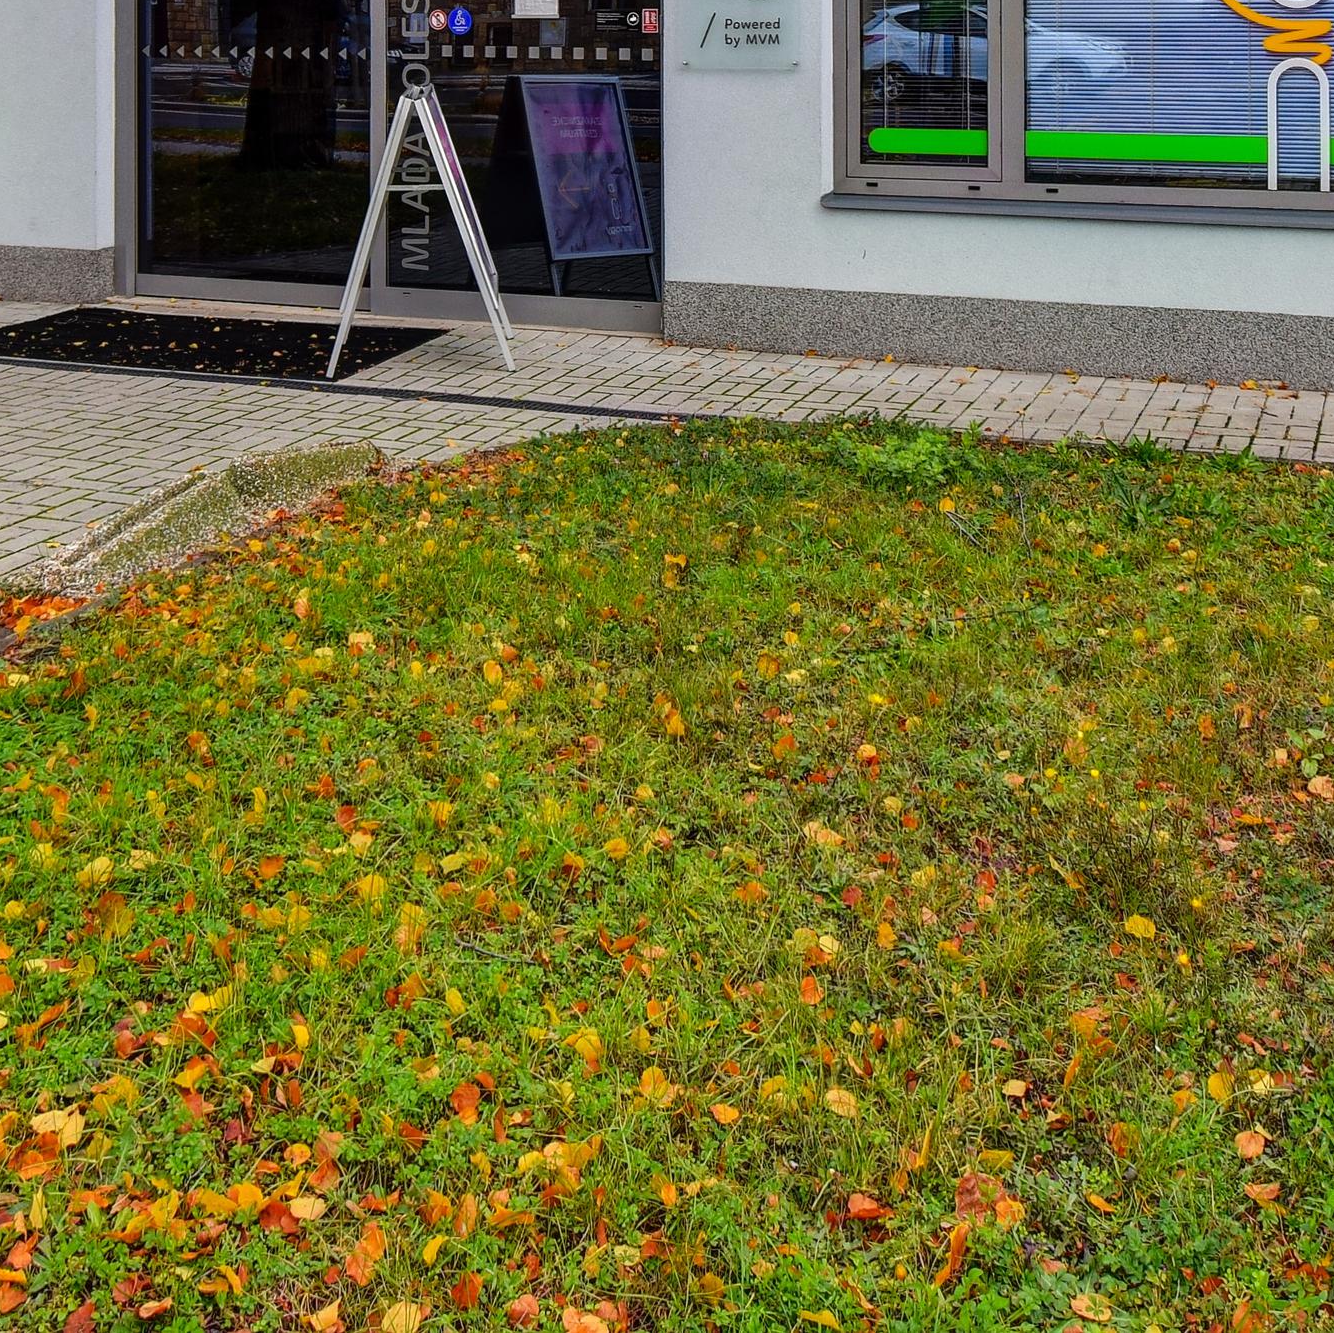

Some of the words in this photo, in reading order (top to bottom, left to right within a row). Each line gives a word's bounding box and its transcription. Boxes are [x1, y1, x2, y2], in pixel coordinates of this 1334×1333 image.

[724, 18, 781, 30] Powered
[724, 33, 741, 48] by
[746, 34, 780, 45] MVM
